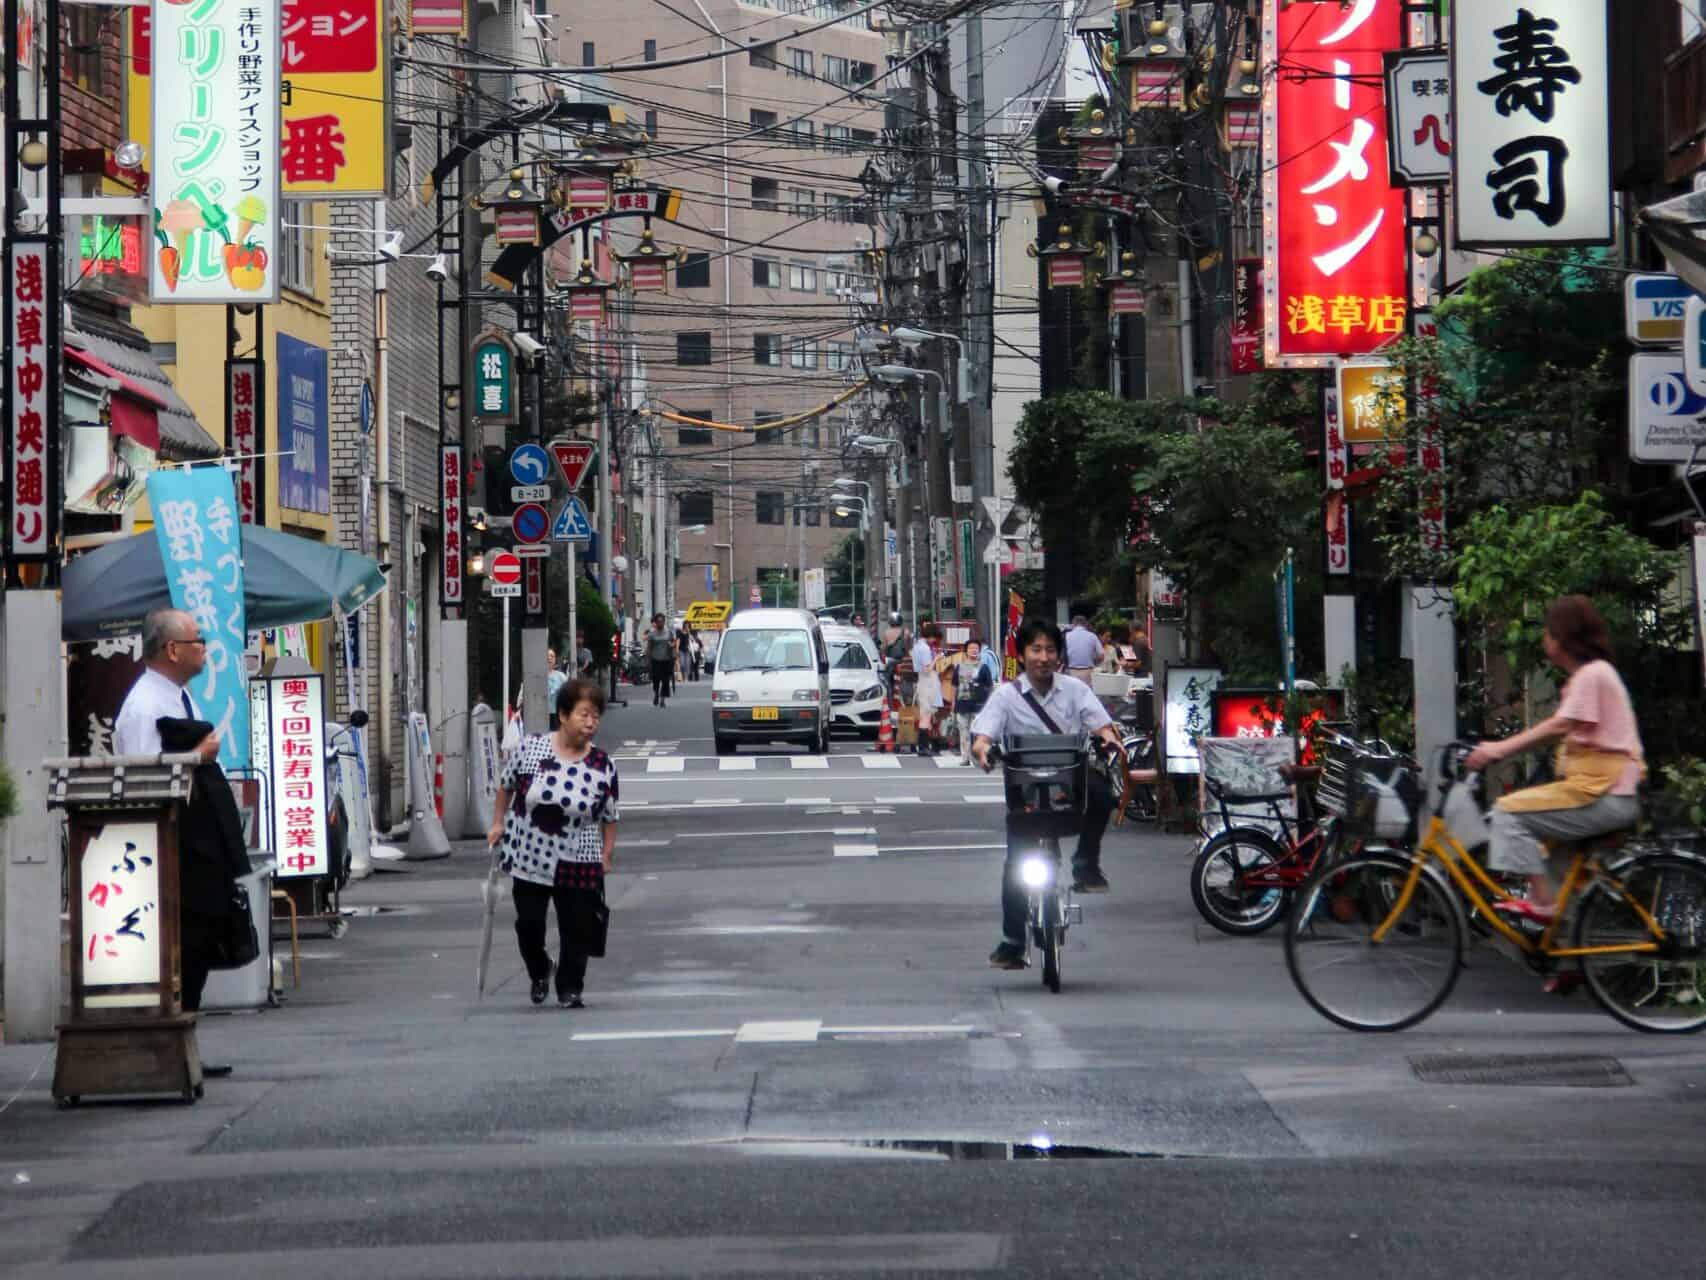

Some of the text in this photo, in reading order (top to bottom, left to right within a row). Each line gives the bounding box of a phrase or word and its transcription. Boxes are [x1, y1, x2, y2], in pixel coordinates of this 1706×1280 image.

[237, 7, 262, 193] 手作り野菜アイスショップ
[1286, 295, 1405, 336] 浅草店
[15, 254, 43, 544] 浅草中央通り
[561, 455, 585, 465] 止まれ
[444, 452, 460, 598] 浅草中央通り
[281, 679, 316, 873] 奥で回転寿司営業中
[87, 881, 123, 961] かに
